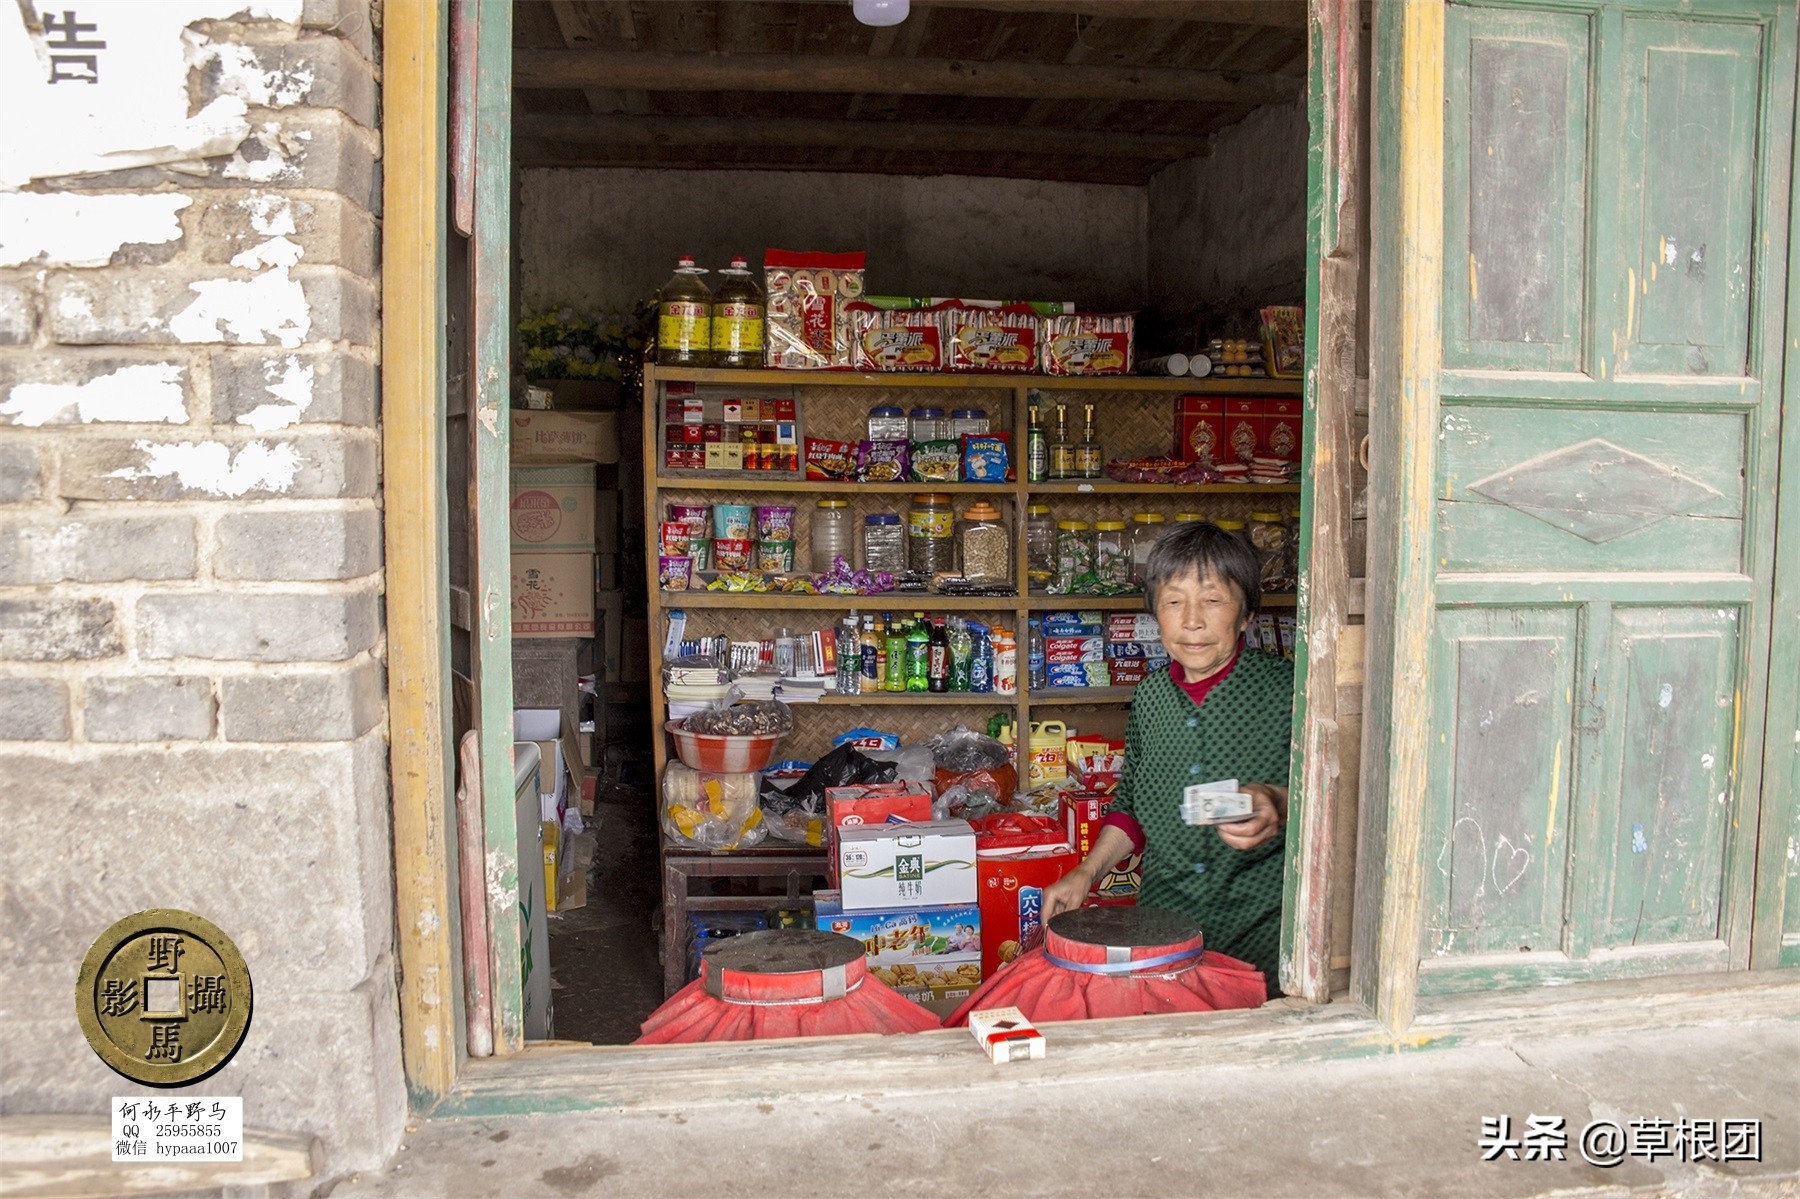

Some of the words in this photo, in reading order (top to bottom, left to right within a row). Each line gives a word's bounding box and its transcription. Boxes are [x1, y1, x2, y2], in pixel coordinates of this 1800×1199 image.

[42, 11, 106, 84] 告
[526, 568, 541, 590] 雪花
[1049, 642, 1078, 651] Colgate
[1049, 654, 1078, 663] Colgate
[898, 857, 921, 874] 金典
[898, 881, 922, 897] 纯牛奶
[1022, 894, 1039, 941] 六个核
[865, 924, 928, 956] 中老年
